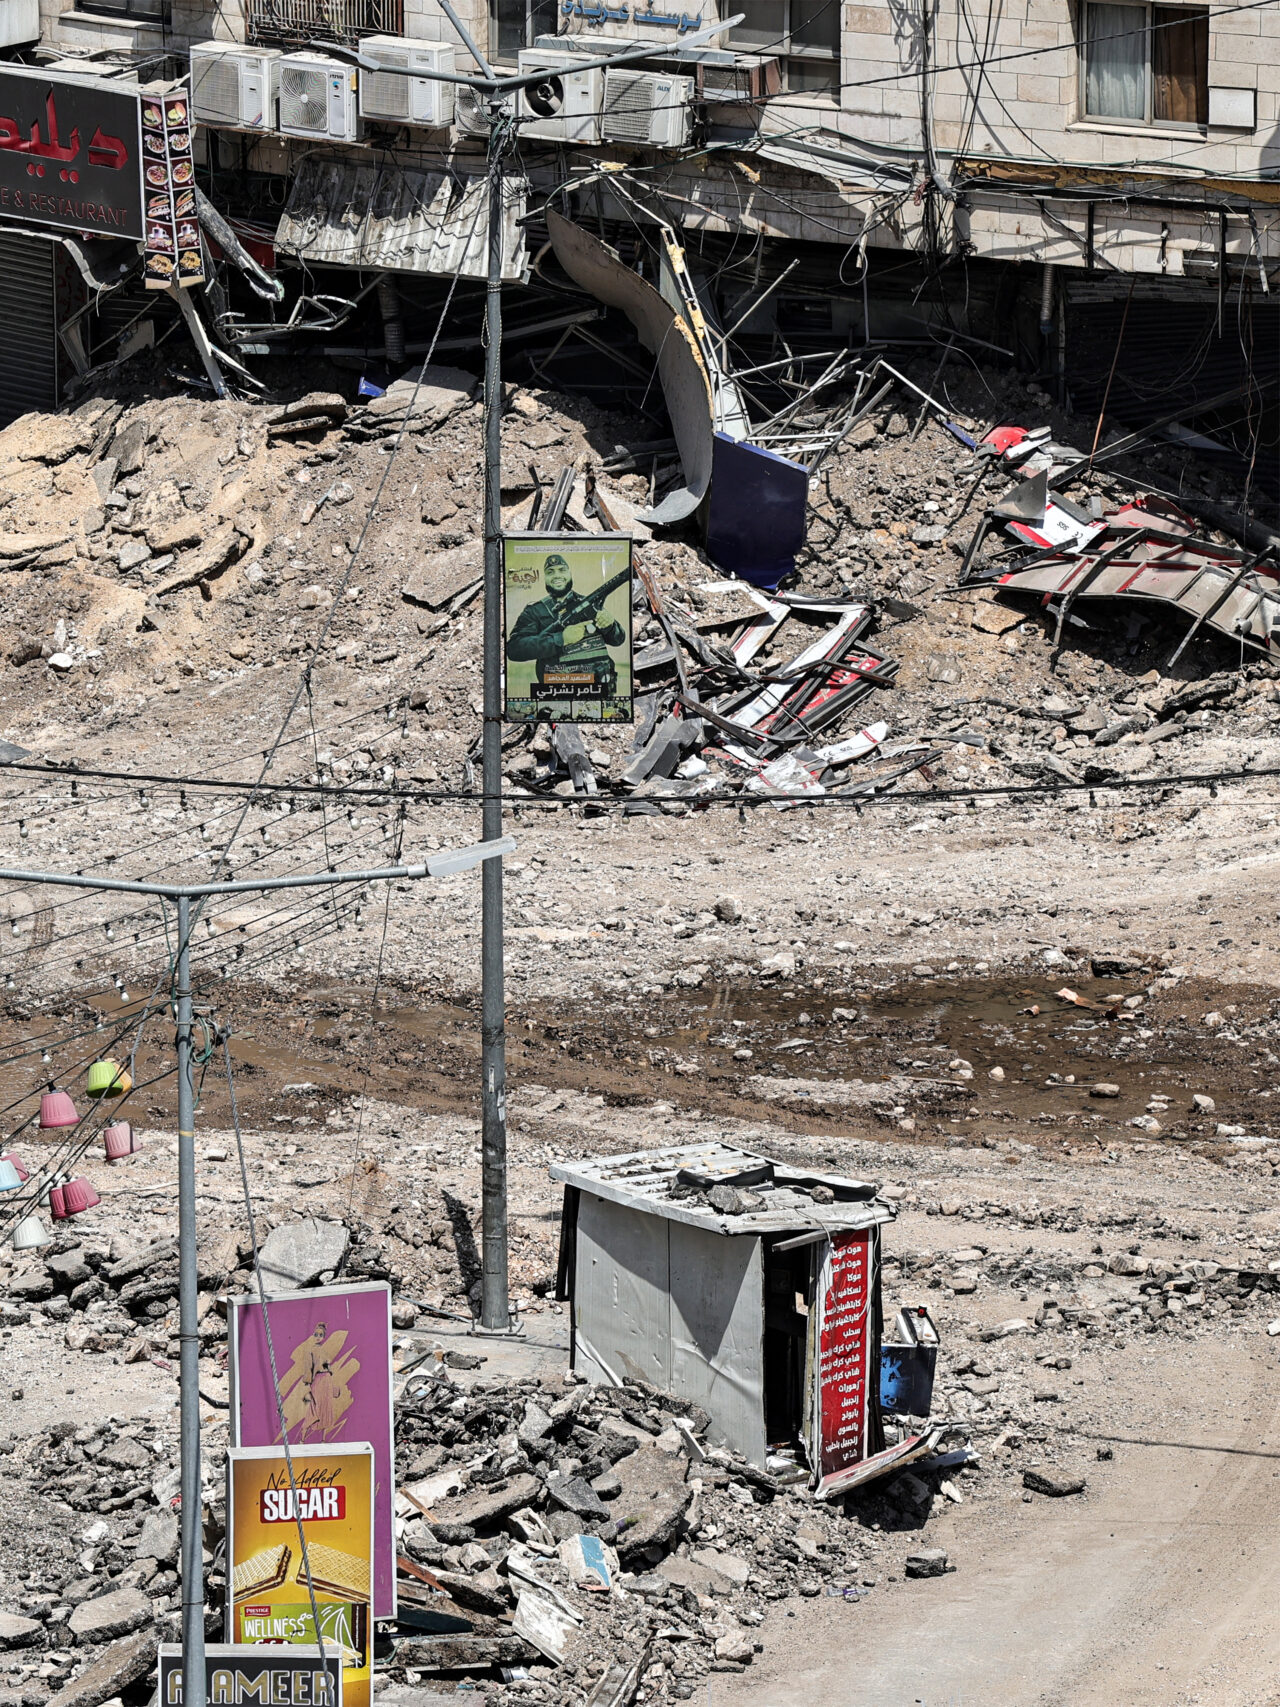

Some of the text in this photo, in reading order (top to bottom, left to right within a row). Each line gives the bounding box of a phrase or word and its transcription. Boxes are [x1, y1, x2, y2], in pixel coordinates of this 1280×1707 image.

[14, 189, 25, 208] &
[29, 191, 128, 226] RESTAURANT
[536, 683, 602, 699] تامر نشرتي
[267, 1467, 342, 1490] No Added
[264, 1487, 339, 1521] SUGAR
[244, 1617, 306, 1638] WELLNESS
[167, 1669, 336, 1706] AAMEER
